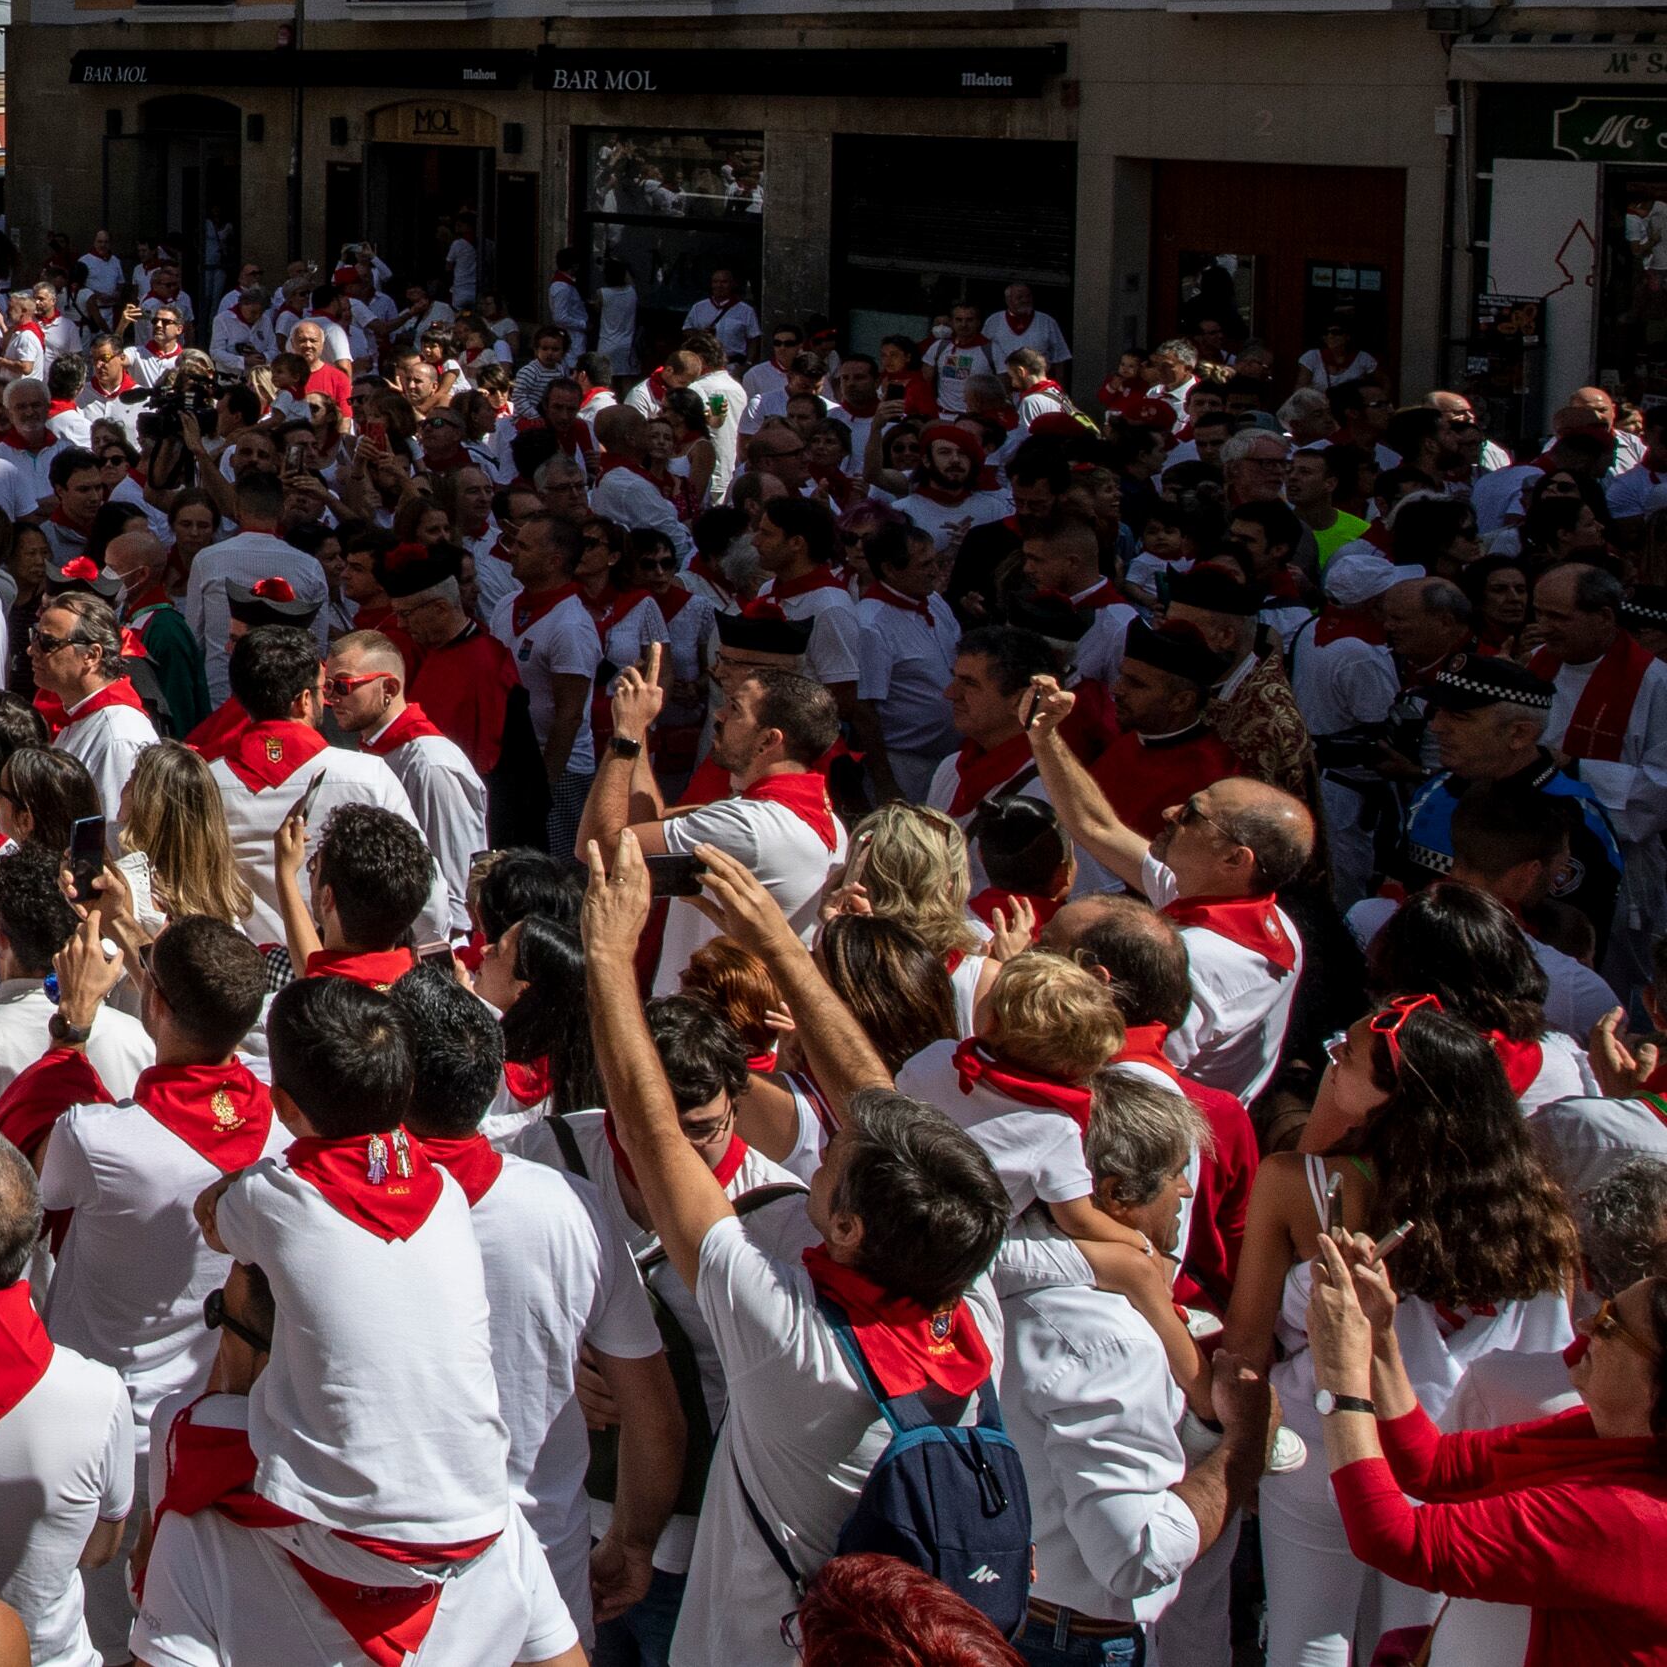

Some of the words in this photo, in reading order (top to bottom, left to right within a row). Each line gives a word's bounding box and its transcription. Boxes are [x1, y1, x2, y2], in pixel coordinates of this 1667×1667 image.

[83, 65, 113, 83] BAR
[114, 65, 149, 83] MOL
[462, 68, 497, 81] Mahou
[552, 69, 599, 90] BAR
[604, 69, 658, 91] MOL
[960, 71, 1014, 87] Mahou
[415, 108, 458, 133] MOL
